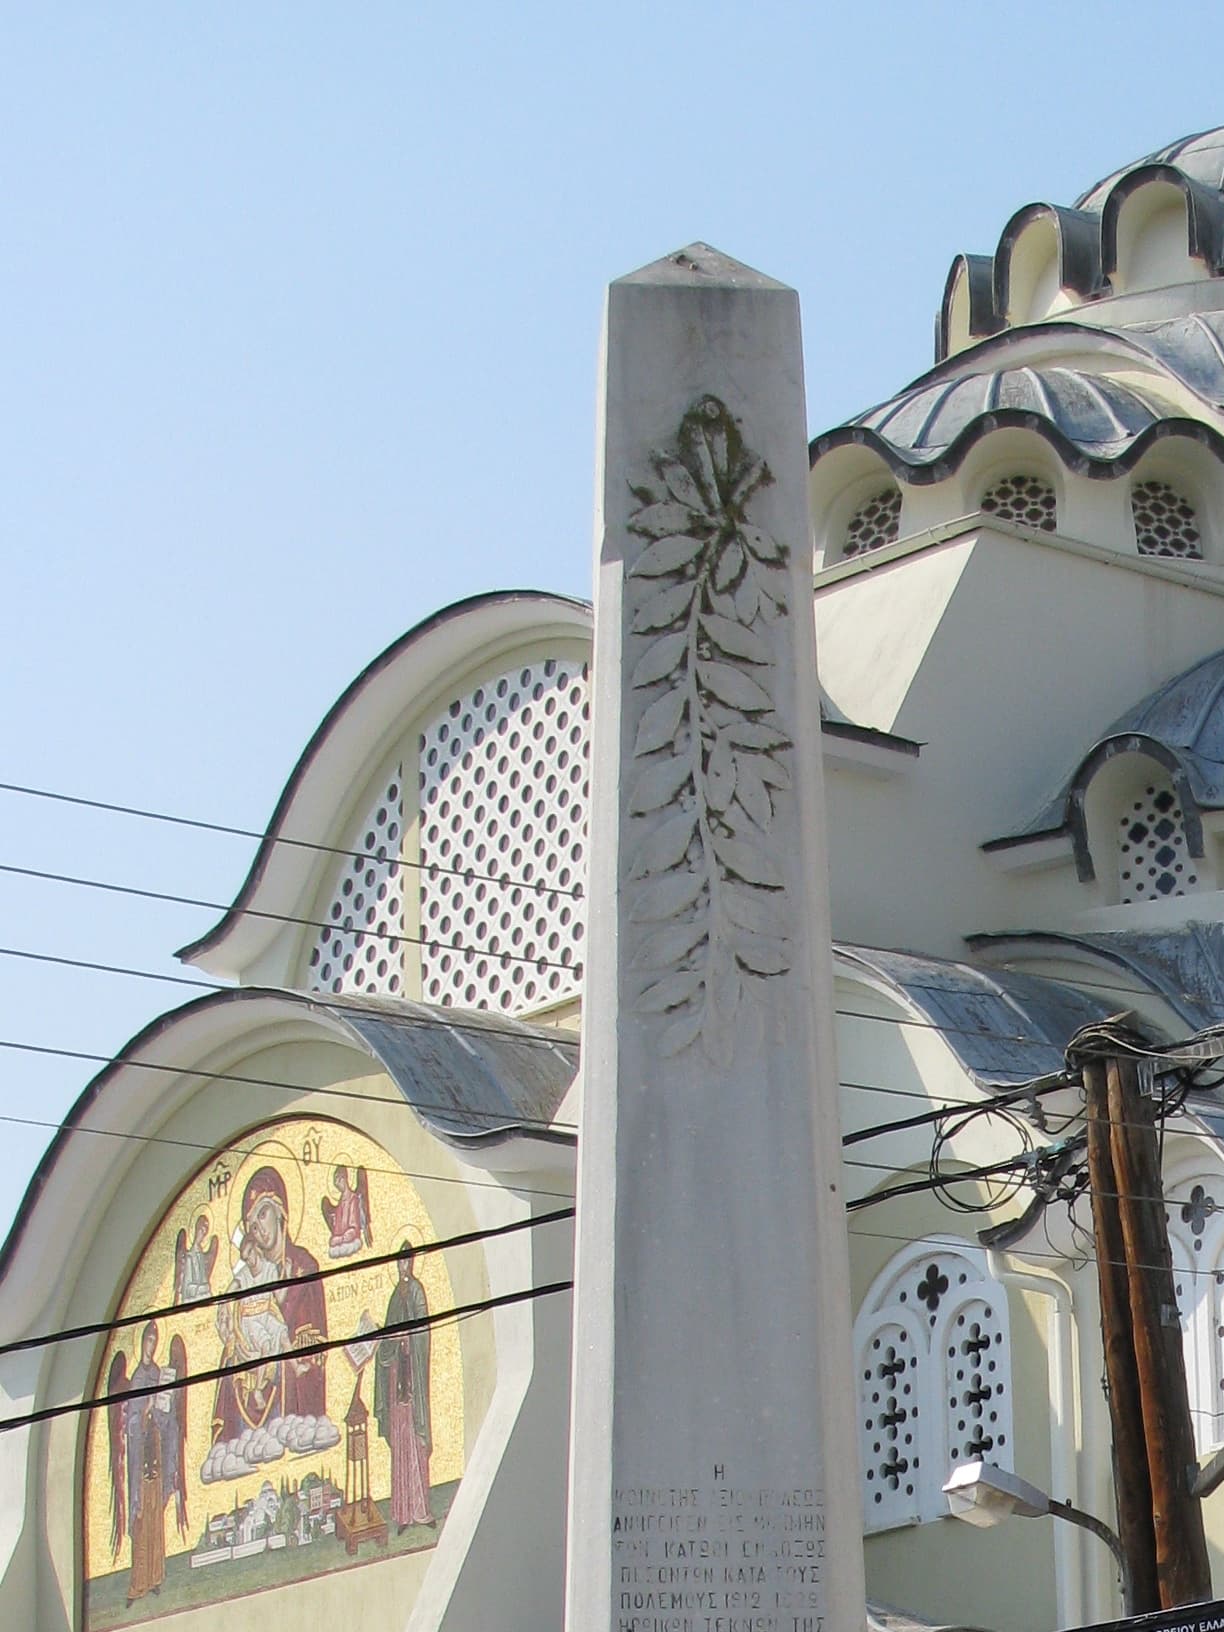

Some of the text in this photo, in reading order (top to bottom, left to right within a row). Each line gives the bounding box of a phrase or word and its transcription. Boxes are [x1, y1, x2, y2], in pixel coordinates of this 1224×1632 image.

[713, 1464, 726, 1481] Η
[724, 1565, 767, 1584] ΚΑΤΑ
[620, 1591, 718, 1610] ΠΟΛΕΜΟΥΣ
